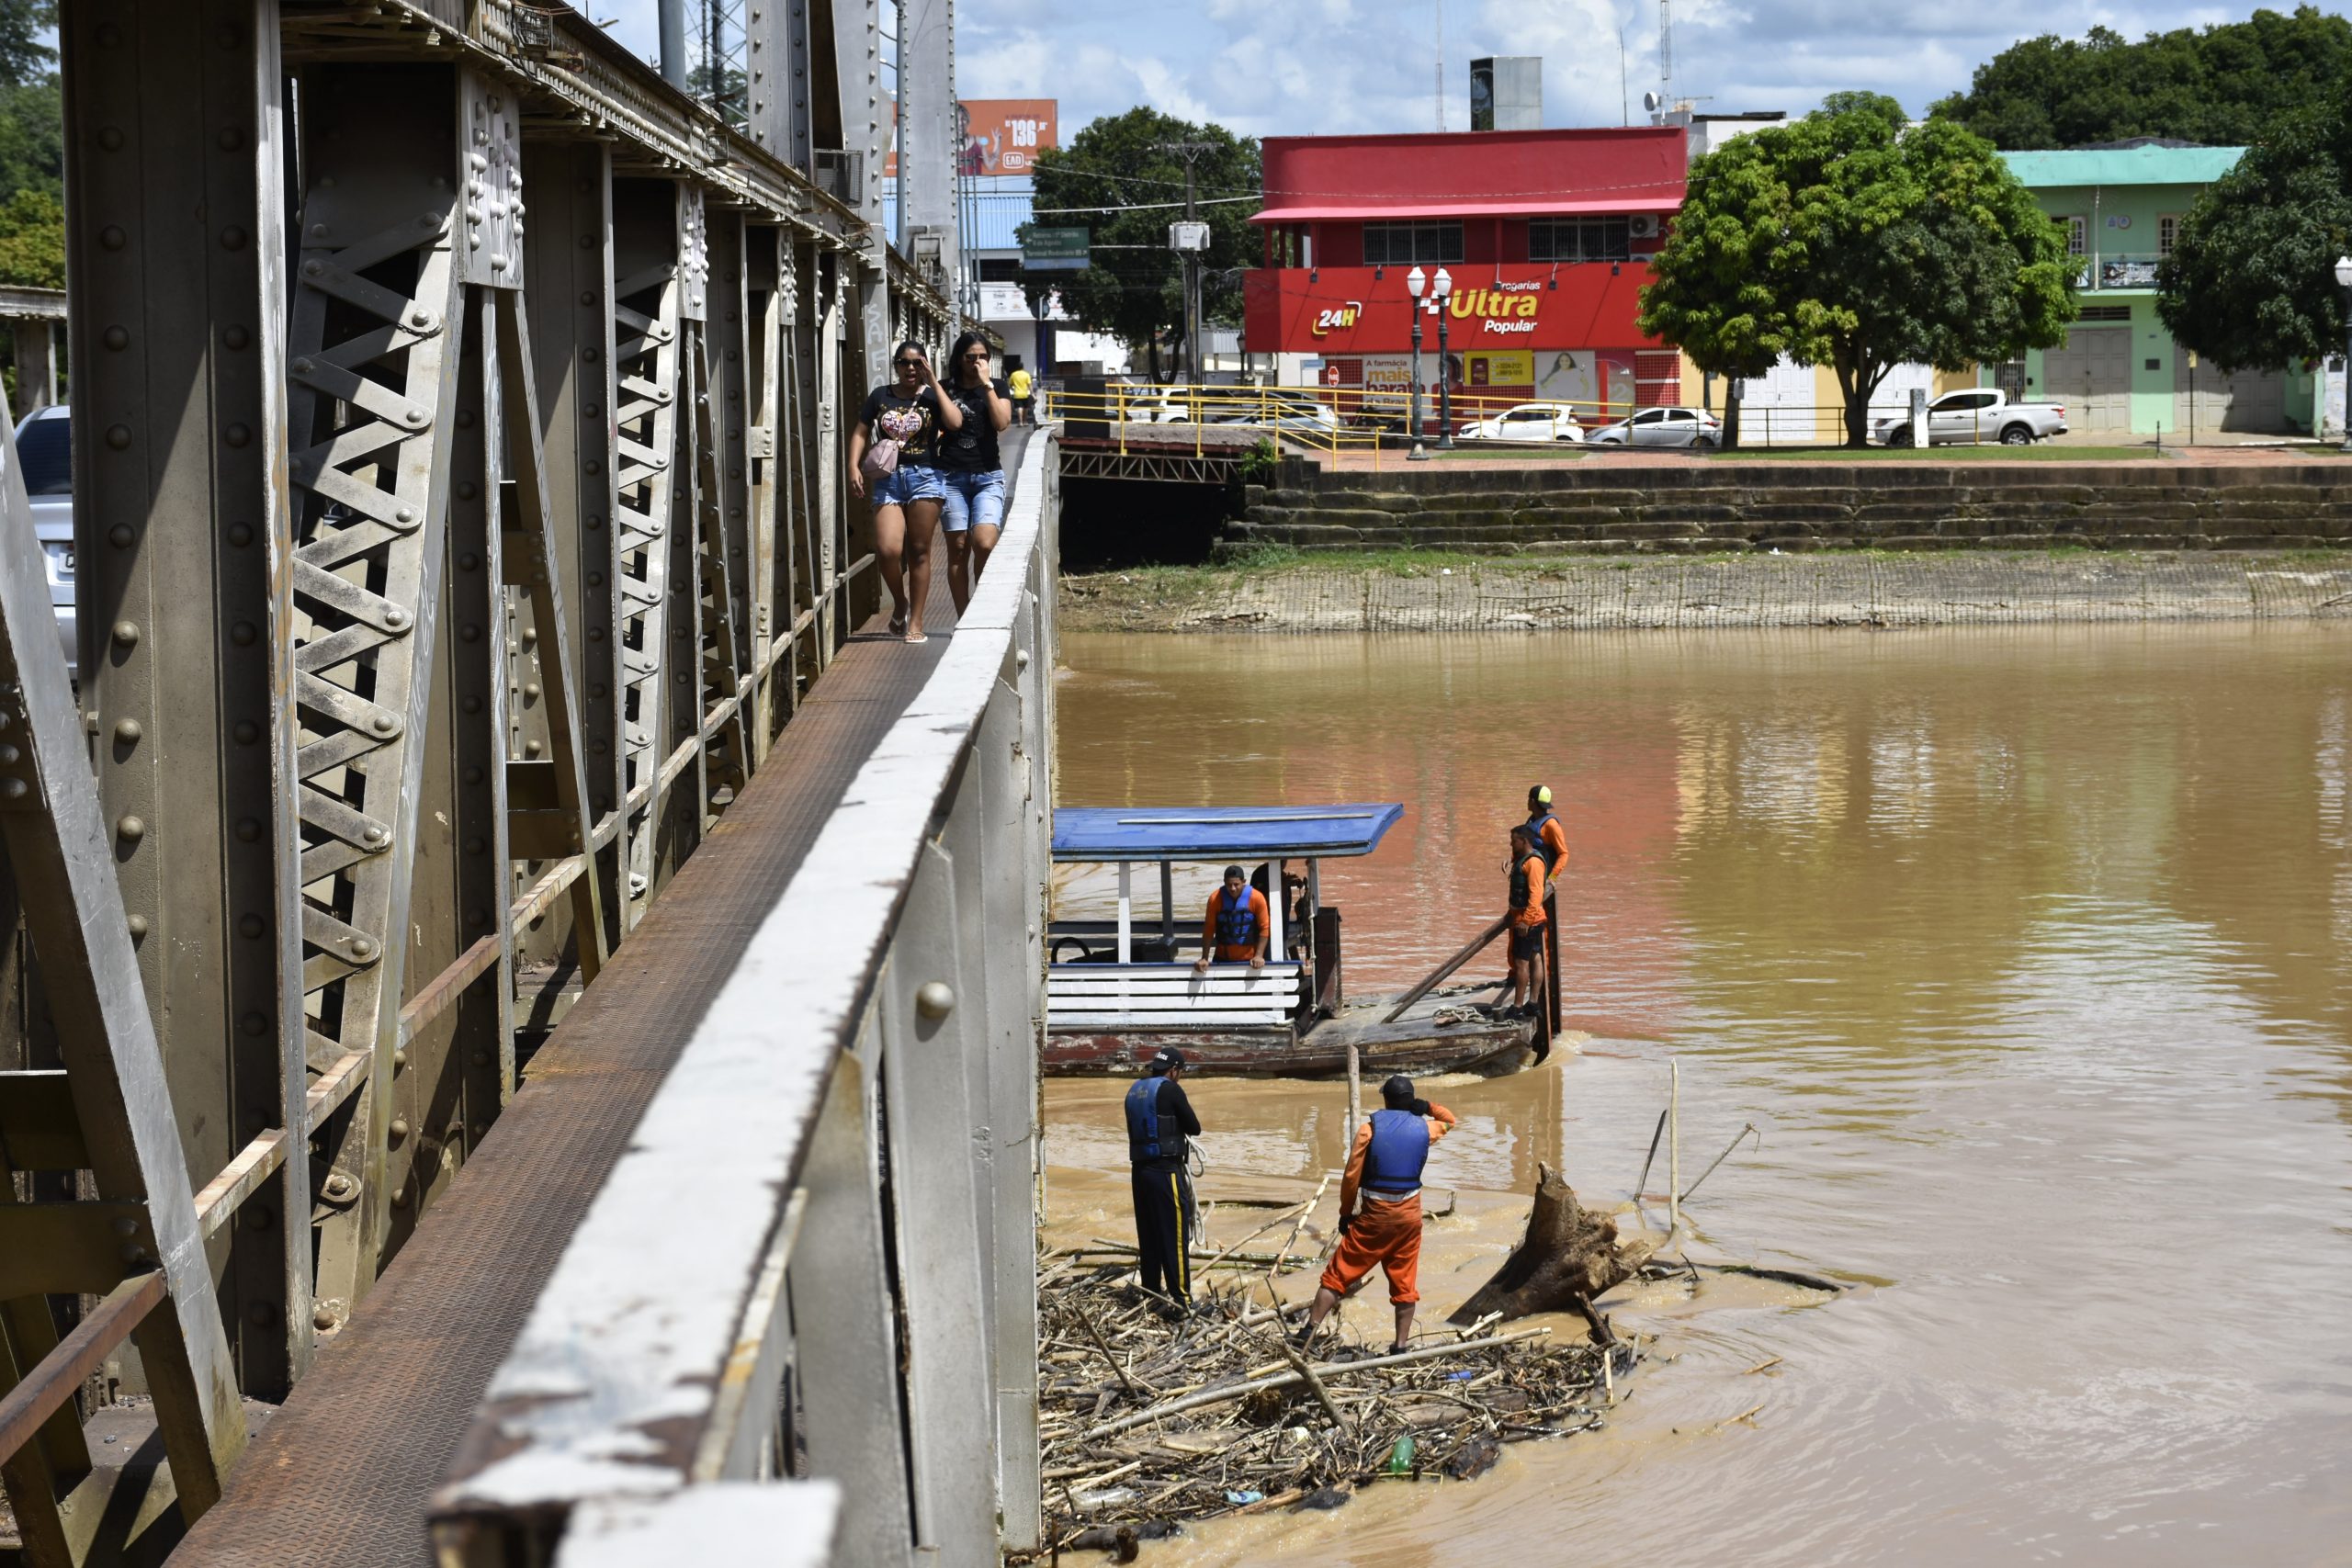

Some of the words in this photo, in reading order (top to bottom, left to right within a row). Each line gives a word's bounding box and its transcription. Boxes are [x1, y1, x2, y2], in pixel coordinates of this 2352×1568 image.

[1495, 280, 1541, 292] rogarias
[1449, 288, 1538, 319] Ultra
[1318, 309, 1356, 328] 24H
[1484, 319, 1538, 334] Popular
[1367, 367, 1412, 382] mais
